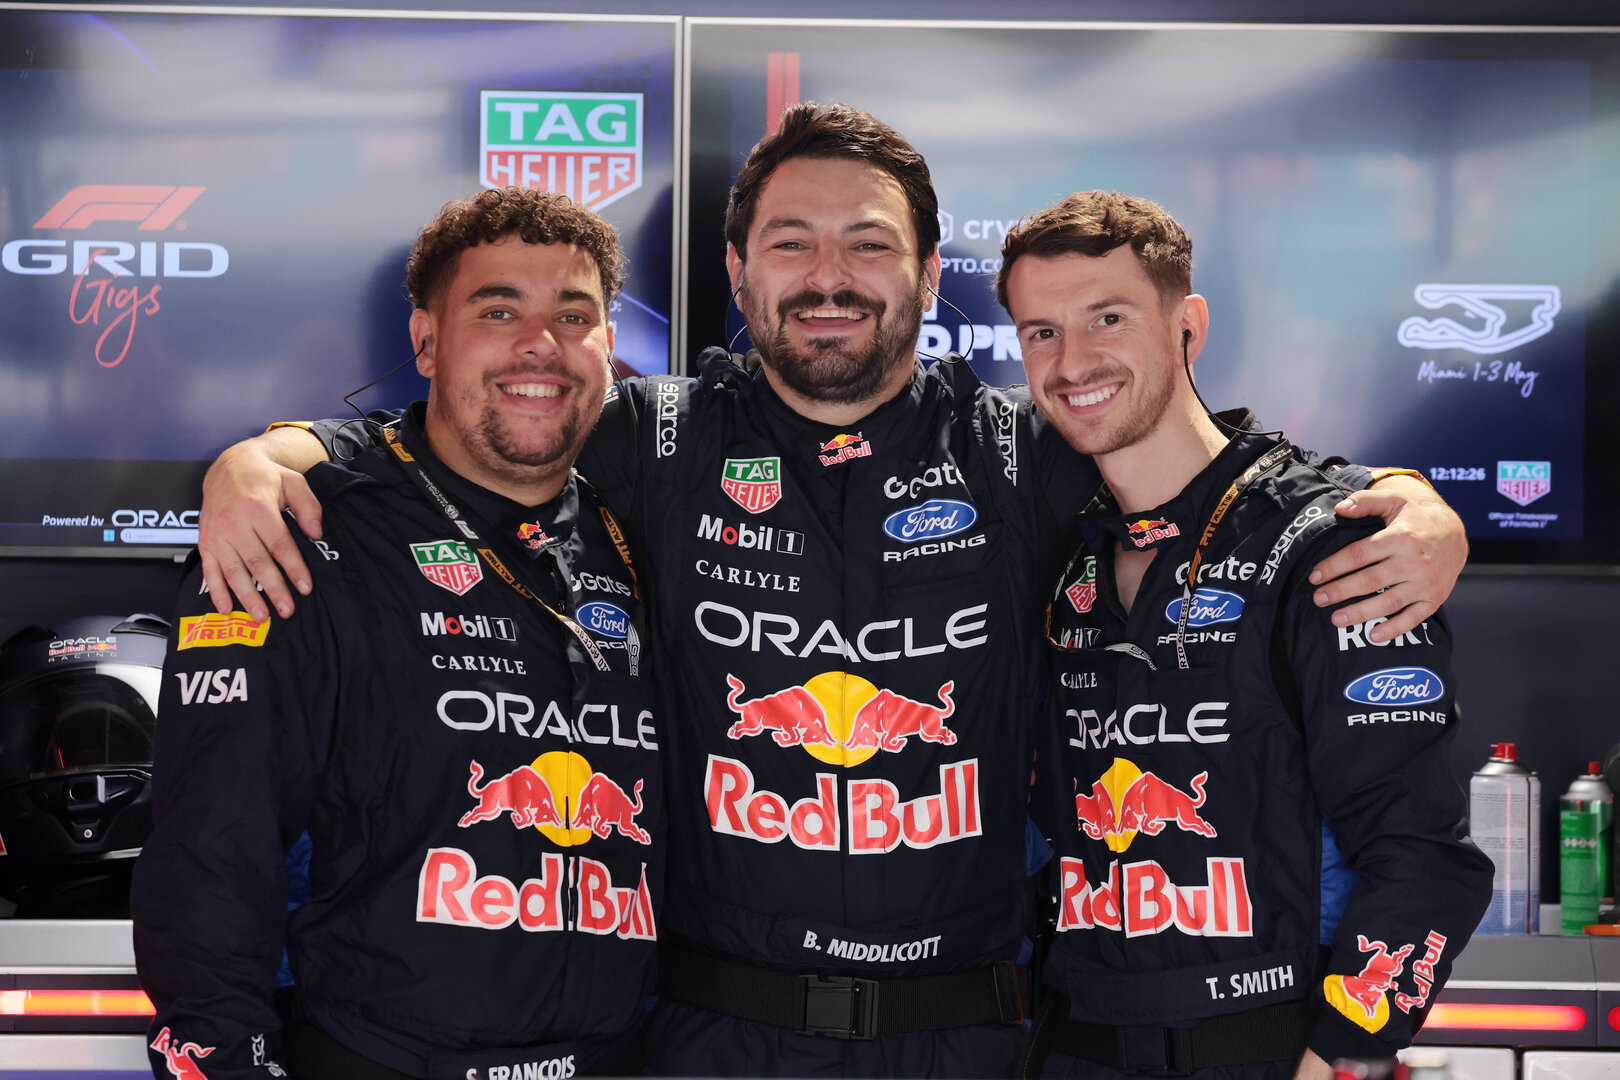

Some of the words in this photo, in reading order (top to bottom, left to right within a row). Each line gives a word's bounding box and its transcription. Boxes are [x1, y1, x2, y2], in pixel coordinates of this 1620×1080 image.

[495, 102, 627, 143] TAG
[491, 154, 631, 203] HEUER
[963, 219, 1014, 248] cry
[1, 239, 229, 278] GRID
[69, 249, 162, 368] Gigs
[1472, 360, 1503, 382] 1-3
[1503, 361, 1540, 398] May
[656, 382, 680, 459] sparco
[818, 448, 847, 467] Red
[843, 440, 872, 459] Bull
[731, 462, 774, 480] TAG
[1429, 467, 1486, 481] 12:12:26
[1503, 463, 1546, 478] TAG
[725, 481, 778, 510] HEUER
[1500, 480, 1548, 500] HEUER
[42, 514, 89, 527] Powered
[697, 513, 773, 551] Mobil
[786, 532, 795, 552] 1
[902, 505, 959, 537] Ford
[1150, 522, 1180, 540] Bull
[1199, 523, 1216, 546] PIT
[416, 544, 472, 562] TAG
[883, 534, 987, 562] RACING
[423, 565, 478, 591] HEUER
[580, 571, 631, 597] Gate
[695, 559, 801, 593] CARLYLE
[1070, 583, 1097, 610] HEUR
[185, 617, 260, 643] PIRELLI
[420, 612, 492, 638] Mobil
[497, 619, 508, 639] 1
[590, 606, 628, 634] Ford
[694, 600, 989, 663] ORACLE
[1177, 597, 1189, 644] ACCESS
[1337, 616, 1434, 651] ROK
[49, 636, 117, 649] ORACLE
[574, 625, 600, 659] ACCESS
[48, 652, 118, 663] RACING
[431, 654, 527, 675] CARLYLE
[174, 667, 248, 705] VISA
[1367, 673, 1430, 702] Ford
[436, 690, 659, 750] ORACLE
[1346, 710, 1447, 727] RACING
[704, 753, 841, 851] Red
[847, 757, 983, 855] Bull
[416, 847, 564, 931] Red
[1122, 857, 1254, 939] Bull
[802, 930, 822, 951] B.
[827, 935, 942, 963] MIDDLICOTT
[1412, 929, 1448, 983] Bull
[1205, 977, 1226, 1000] T.
[1230, 964, 1295, 998] SMITH
